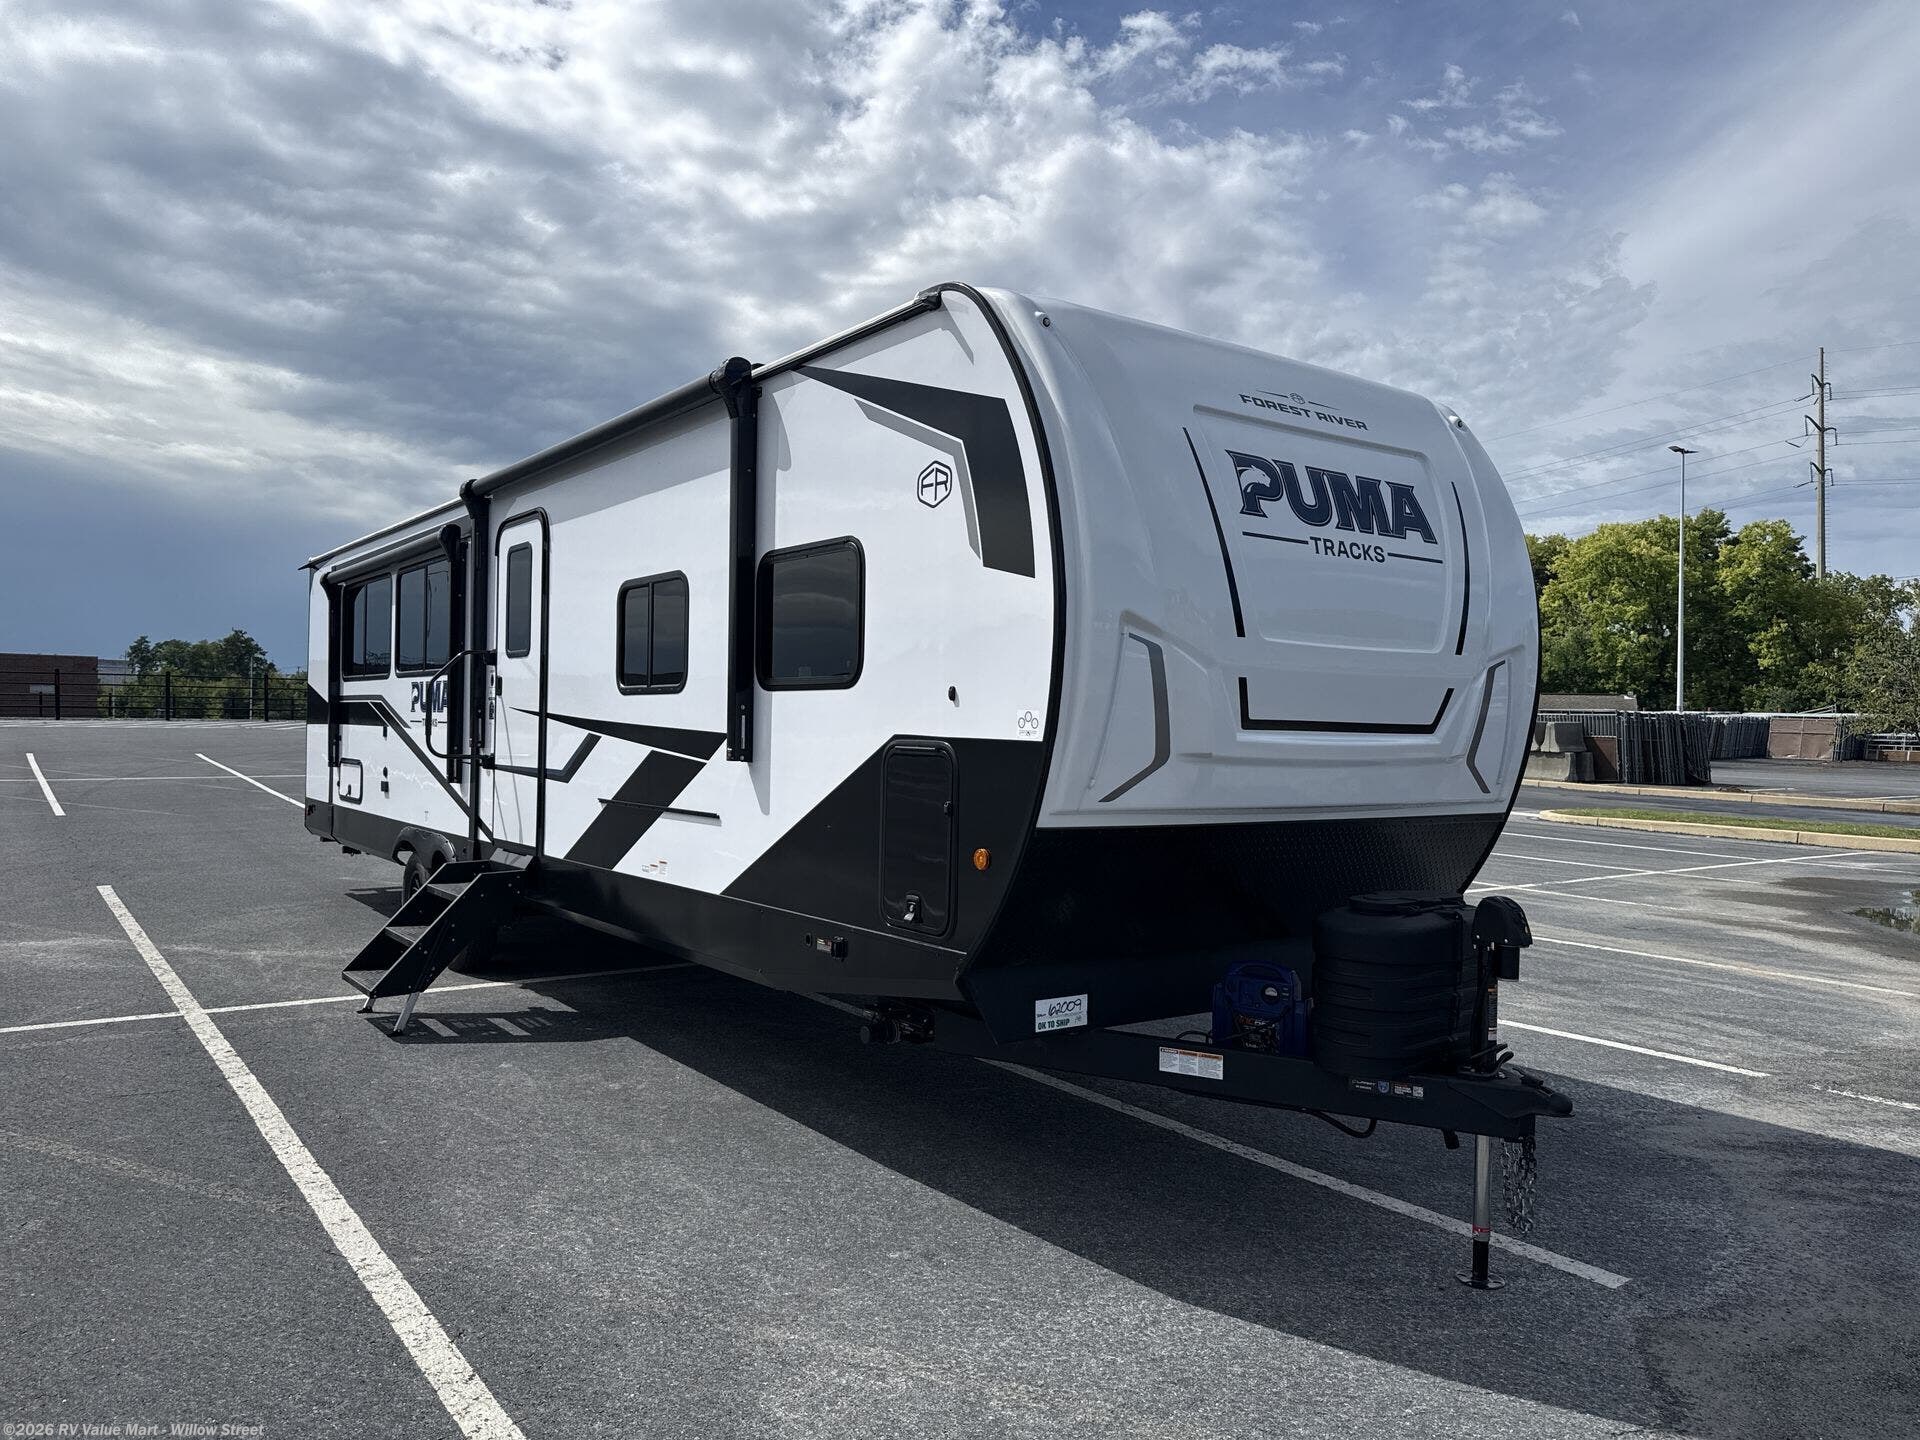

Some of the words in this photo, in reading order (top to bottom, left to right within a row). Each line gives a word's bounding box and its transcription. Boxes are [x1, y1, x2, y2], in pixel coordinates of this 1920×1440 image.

[1239, 393, 1311, 418] FOREST
[1314, 411, 1368, 431] RIVER
[1225, 449, 1438, 544] PUMA
[1309, 536, 1385, 563] TRACKS
[1037, 1022, 1046, 1030] OK
[1047, 1020, 1055, 1029] TO
[1056, 1018, 1070, 1027] SHIP
